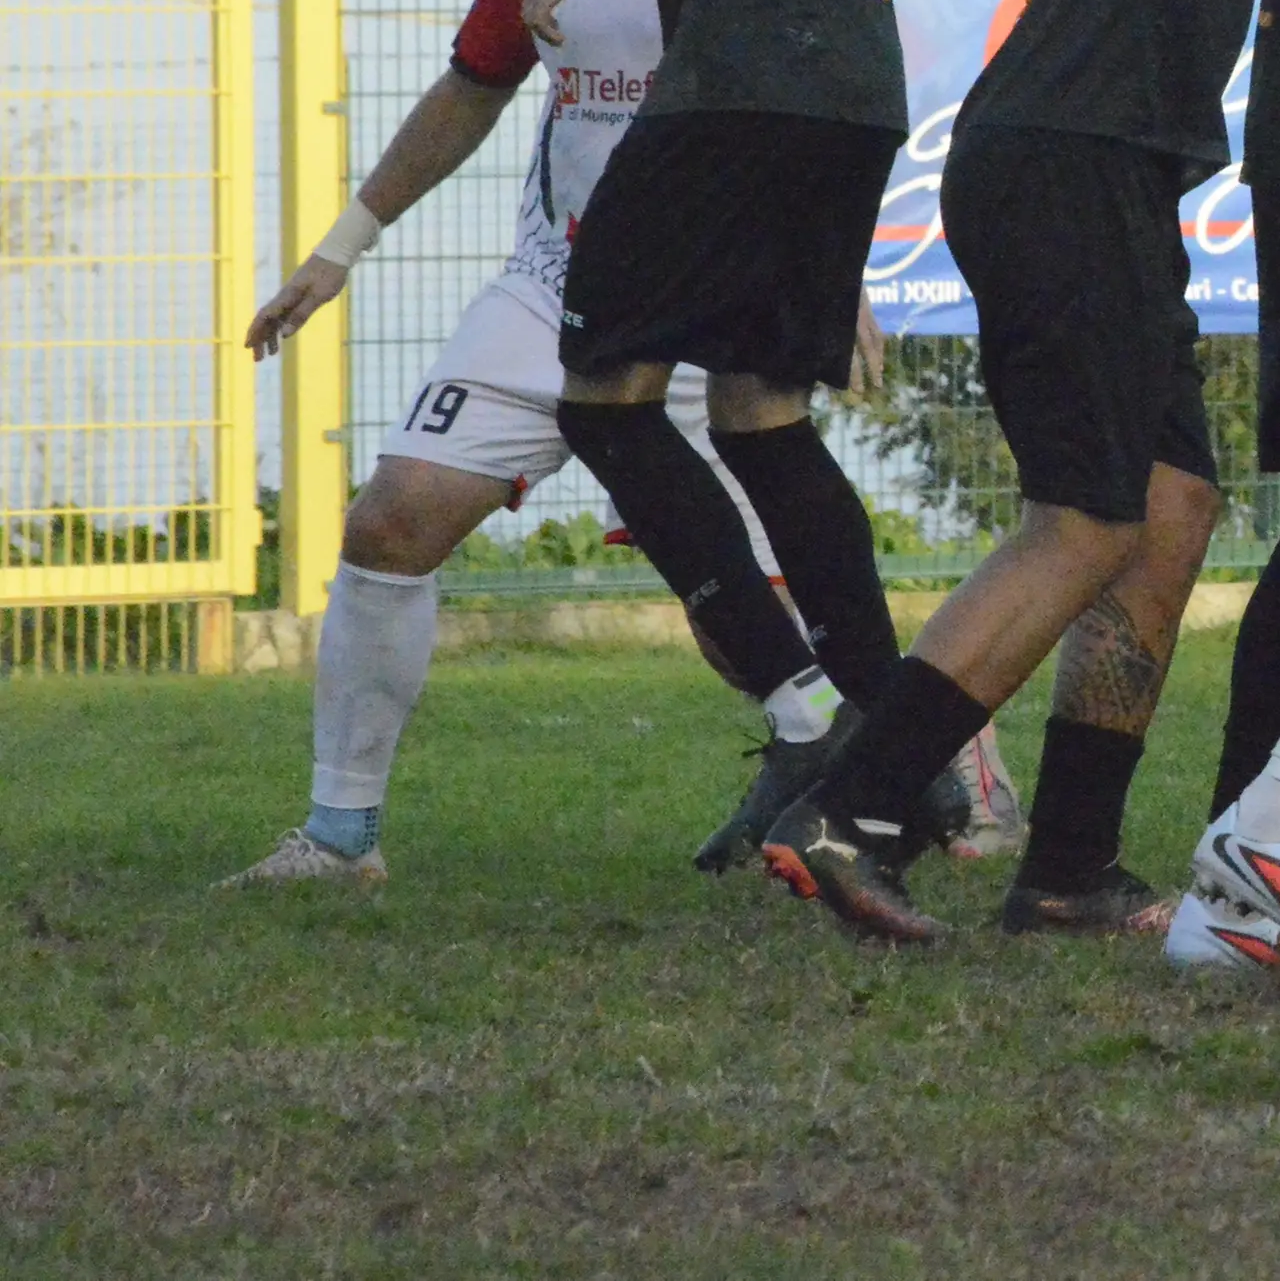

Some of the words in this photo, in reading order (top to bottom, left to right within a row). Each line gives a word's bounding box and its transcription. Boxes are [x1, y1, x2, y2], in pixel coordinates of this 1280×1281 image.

[584, 70, 655, 103] Telef
[904, 280, 961, 303] XXIII
[404, 382, 468, 435] 19
